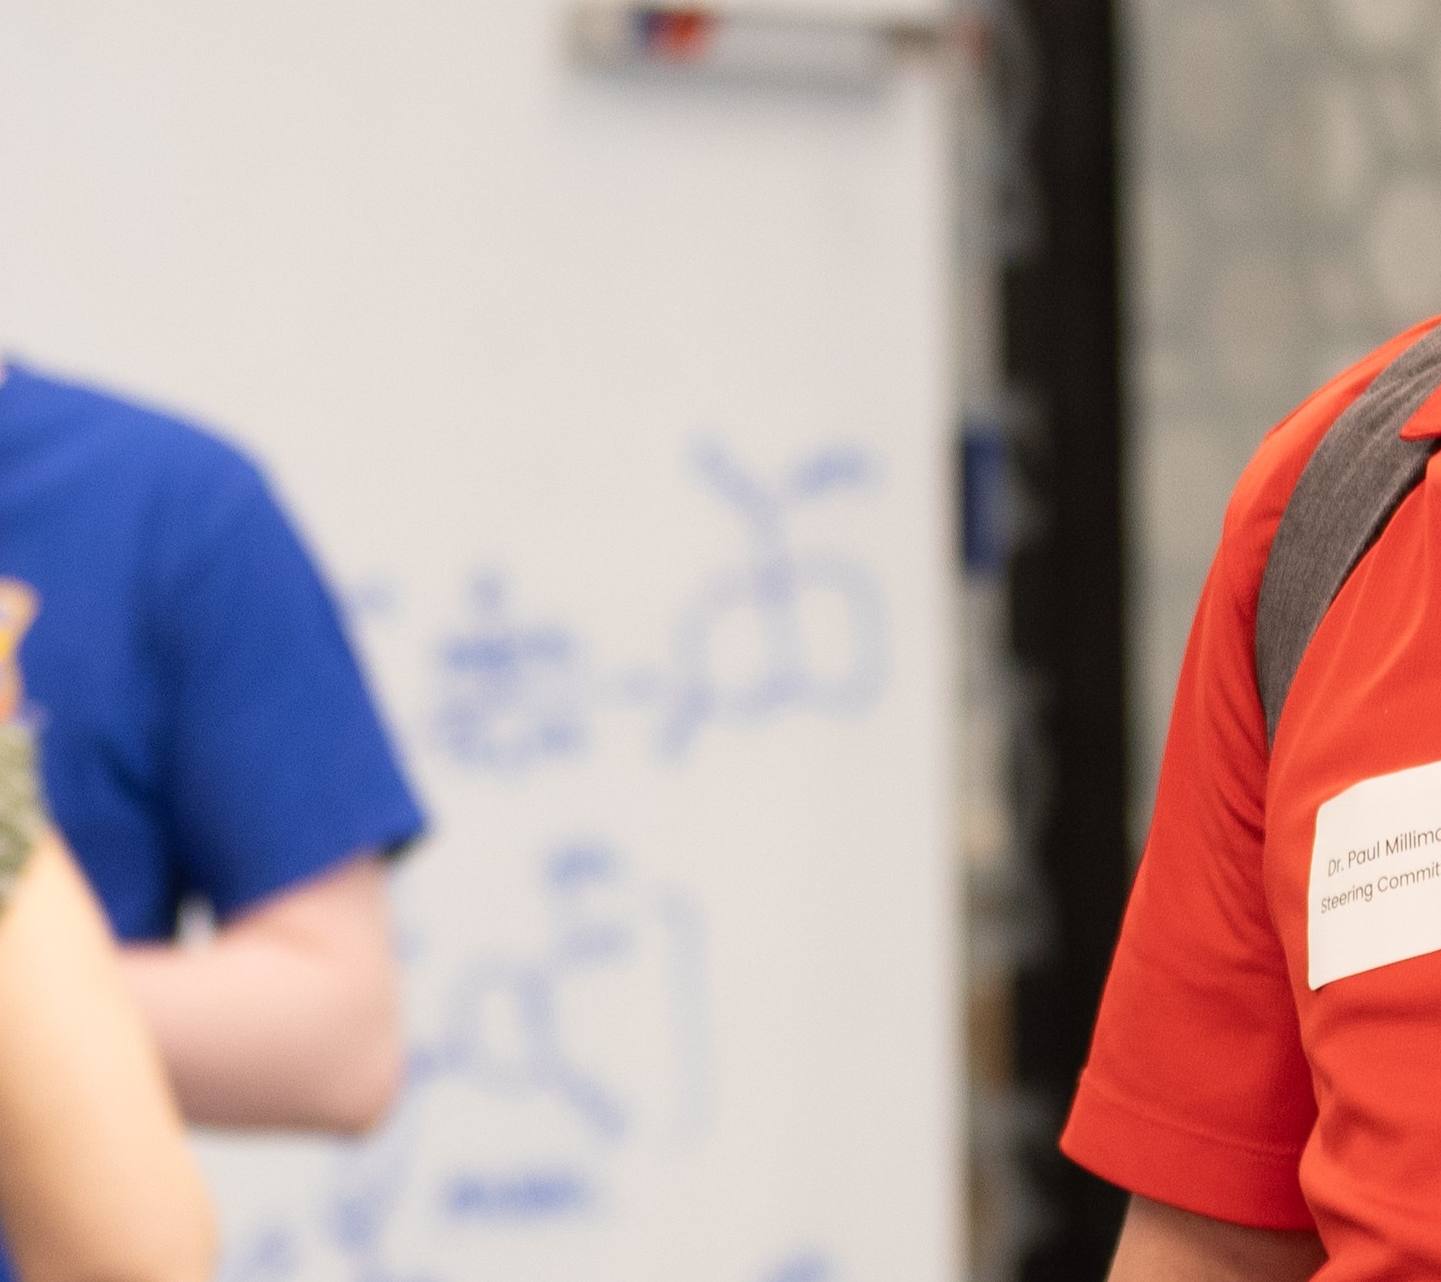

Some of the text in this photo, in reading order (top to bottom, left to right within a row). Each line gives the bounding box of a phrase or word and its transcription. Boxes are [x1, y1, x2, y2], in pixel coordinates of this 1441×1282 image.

[1327, 858, 1345, 878] Dr.
[1348, 840, 1380, 869] Paul
[1320, 881, 1374, 914] Steering
